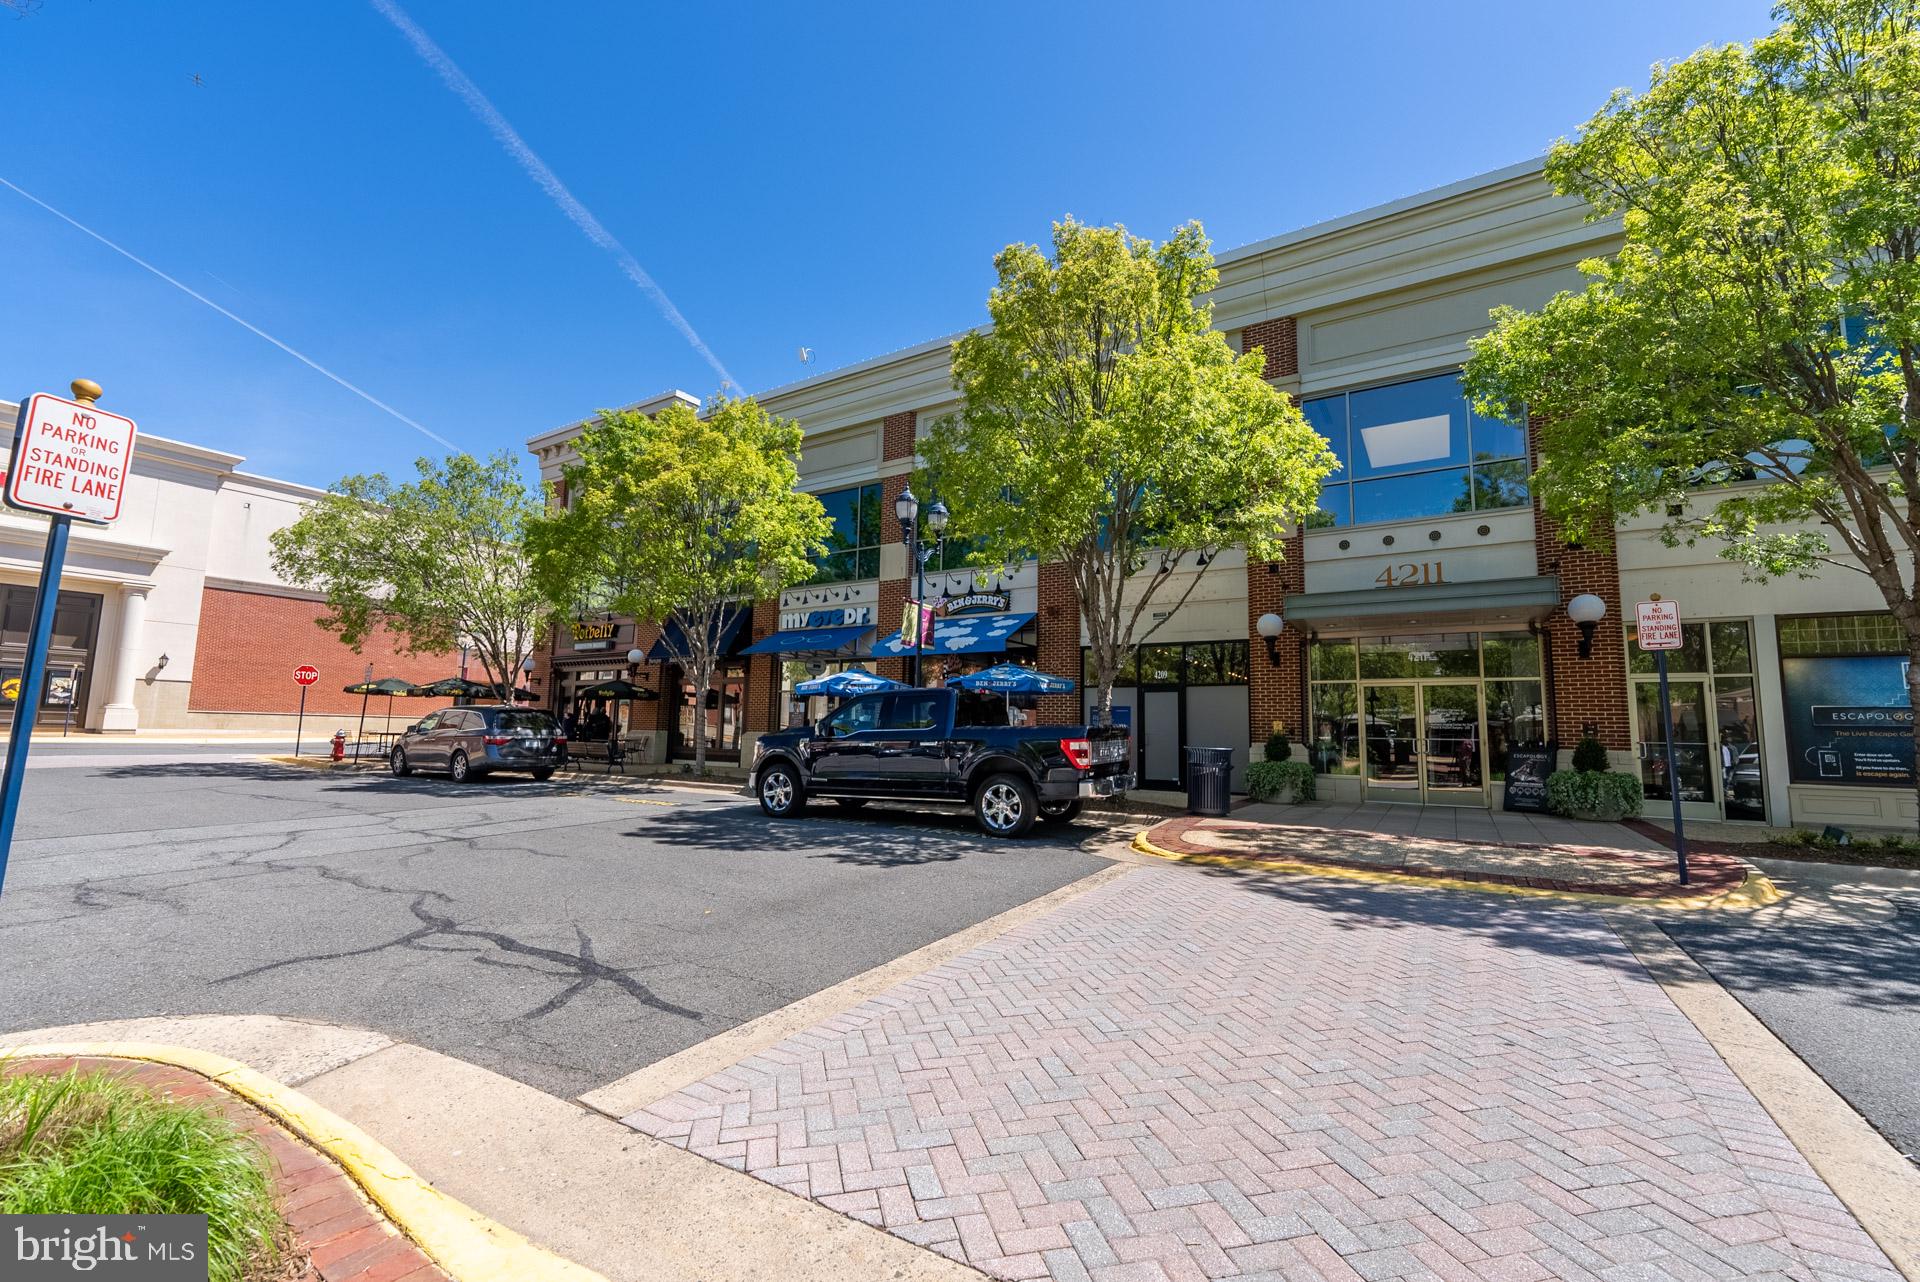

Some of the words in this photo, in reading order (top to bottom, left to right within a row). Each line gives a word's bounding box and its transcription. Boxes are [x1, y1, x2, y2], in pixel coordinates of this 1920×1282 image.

[73, 413, 97, 430] NO
[42, 423, 119, 454] PARKING
[72, 447, 87, 457] OR
[30, 448, 119, 480] STANDING
[23, 465, 66, 489] FIRE
[71, 476, 118, 501] LANE
[1375, 561, 1445, 587] 4211
[1642, 613, 1674, 621] PARKING
[1642, 624, 1677, 632] STANDING
[1641, 632, 1657, 640] FIRE
[1660, 631, 1678, 639] LANE
[295, 671, 318, 680] STOP
[1154, 671, 1168, 679] 4209
[1832, 712, 1914, 720] ESCAPOLOG
